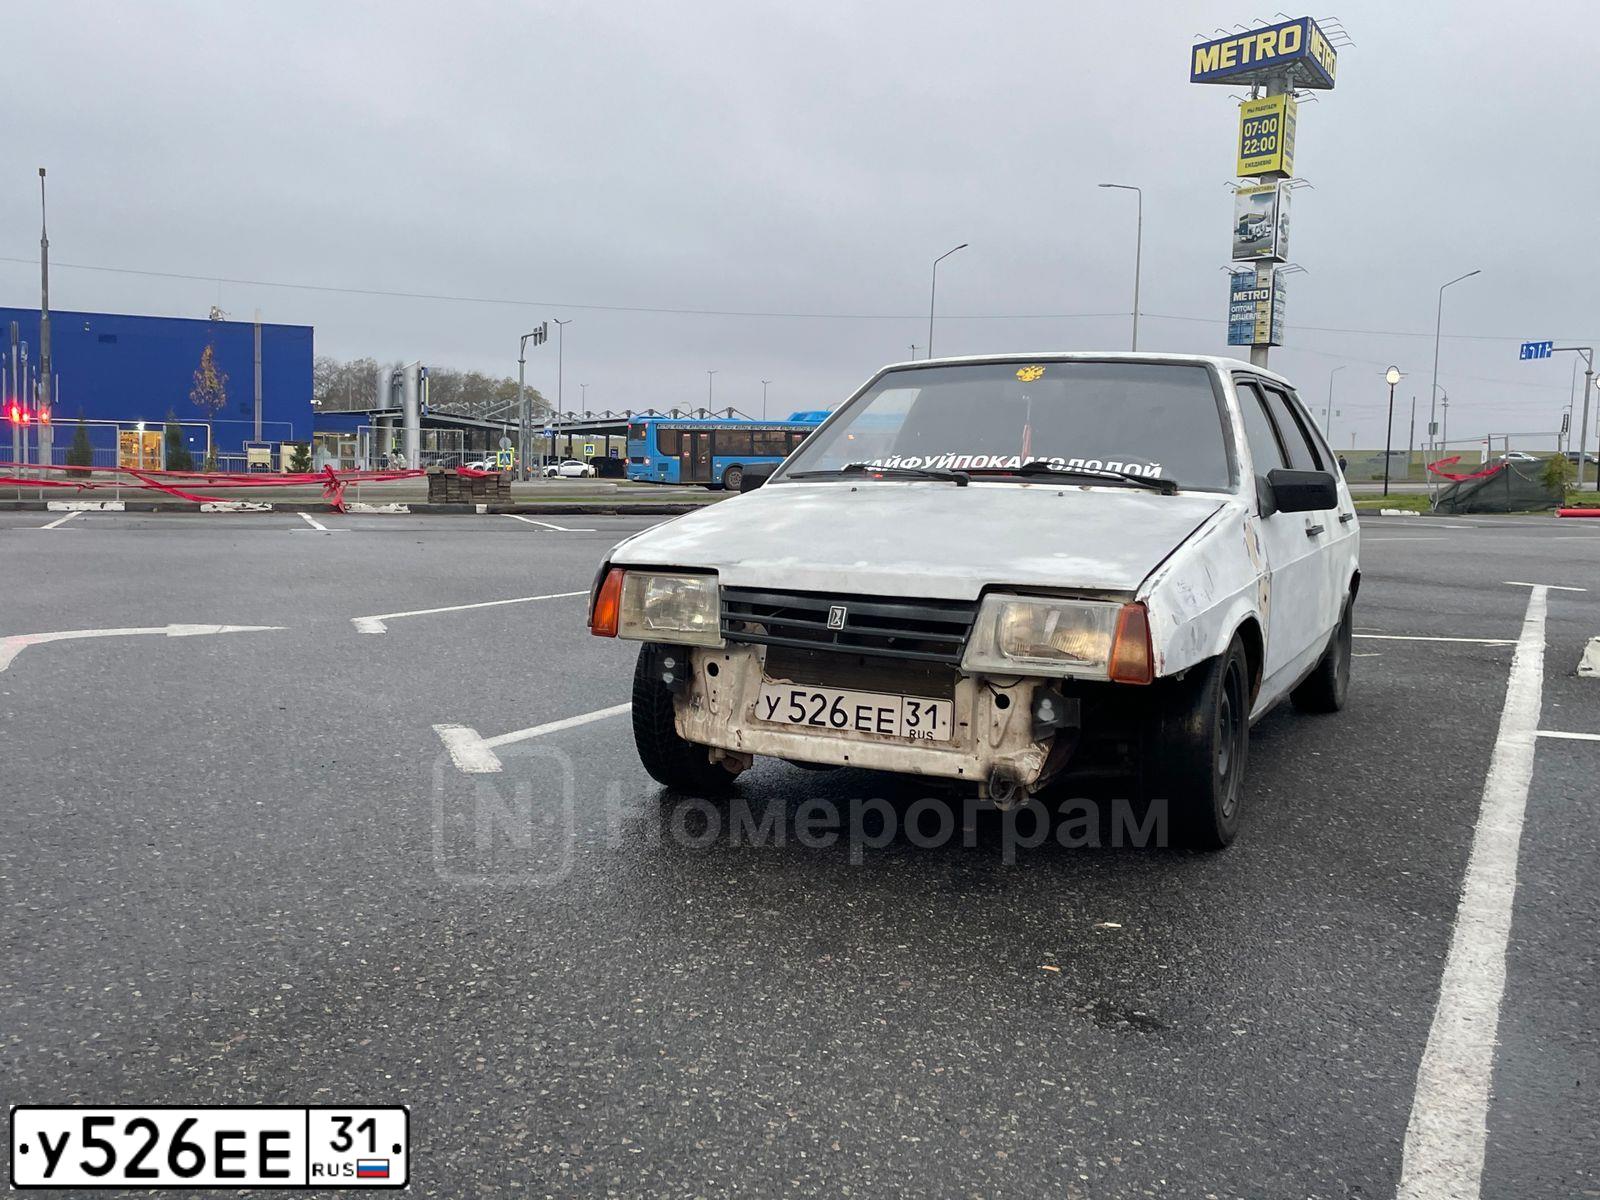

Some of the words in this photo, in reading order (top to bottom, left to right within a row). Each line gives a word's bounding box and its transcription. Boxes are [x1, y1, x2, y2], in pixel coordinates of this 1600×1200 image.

[1194, 24, 1302, 75] METRO
[1310, 25, 1336, 81] METRO
[1244, 118, 1277, 137] 07:00
[1243, 135, 1276, 155] 22:00
[1233, 290, 1269, 301] METRO
[905, 701, 938, 730] 31
[908, 728, 934, 741] RUS
